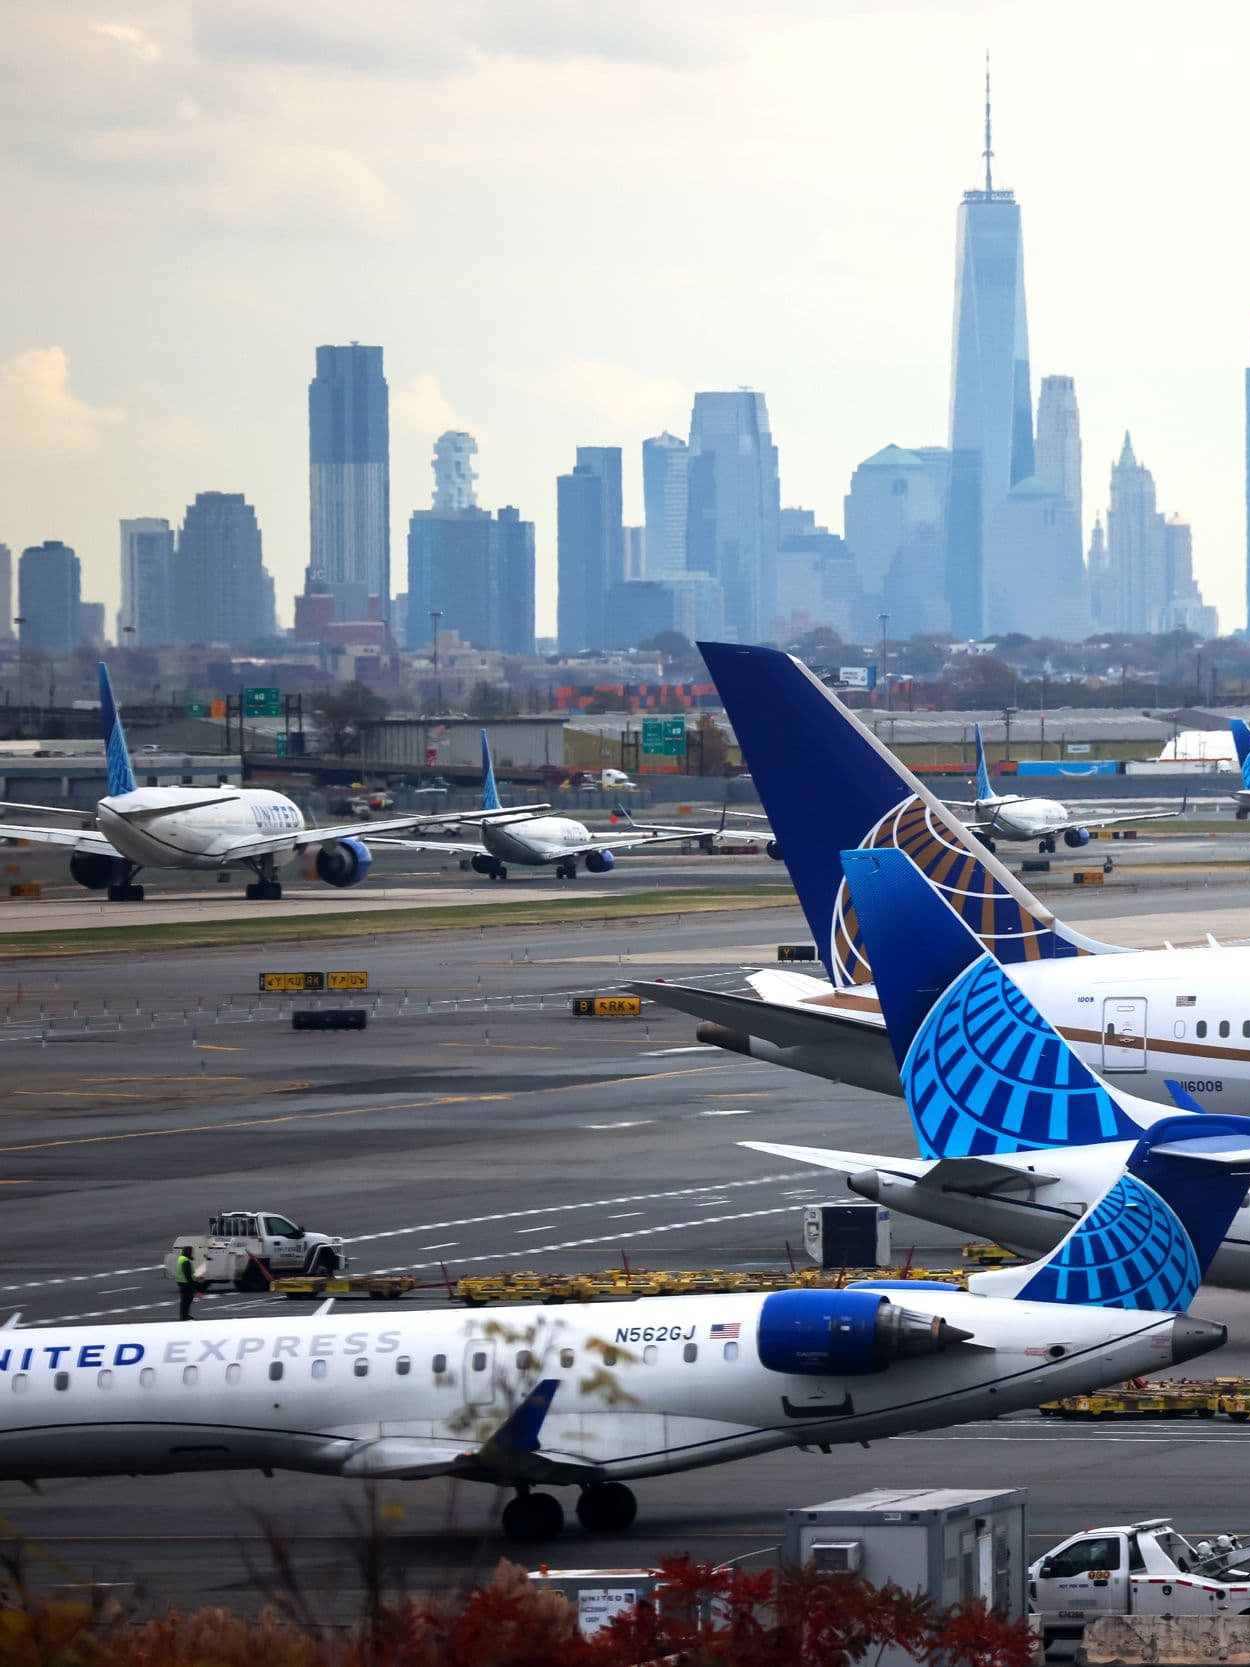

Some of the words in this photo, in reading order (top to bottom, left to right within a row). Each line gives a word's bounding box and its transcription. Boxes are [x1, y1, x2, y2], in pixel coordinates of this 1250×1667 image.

[251, 805, 299, 828] UNITED
[305, 976, 320, 986] RK
[580, 1001, 588, 1012] B
[608, 1001, 625, 1012] RK
[615, 1324, 697, 1343] N562GJ
[162, 1331, 402, 1363] EXPRESS
